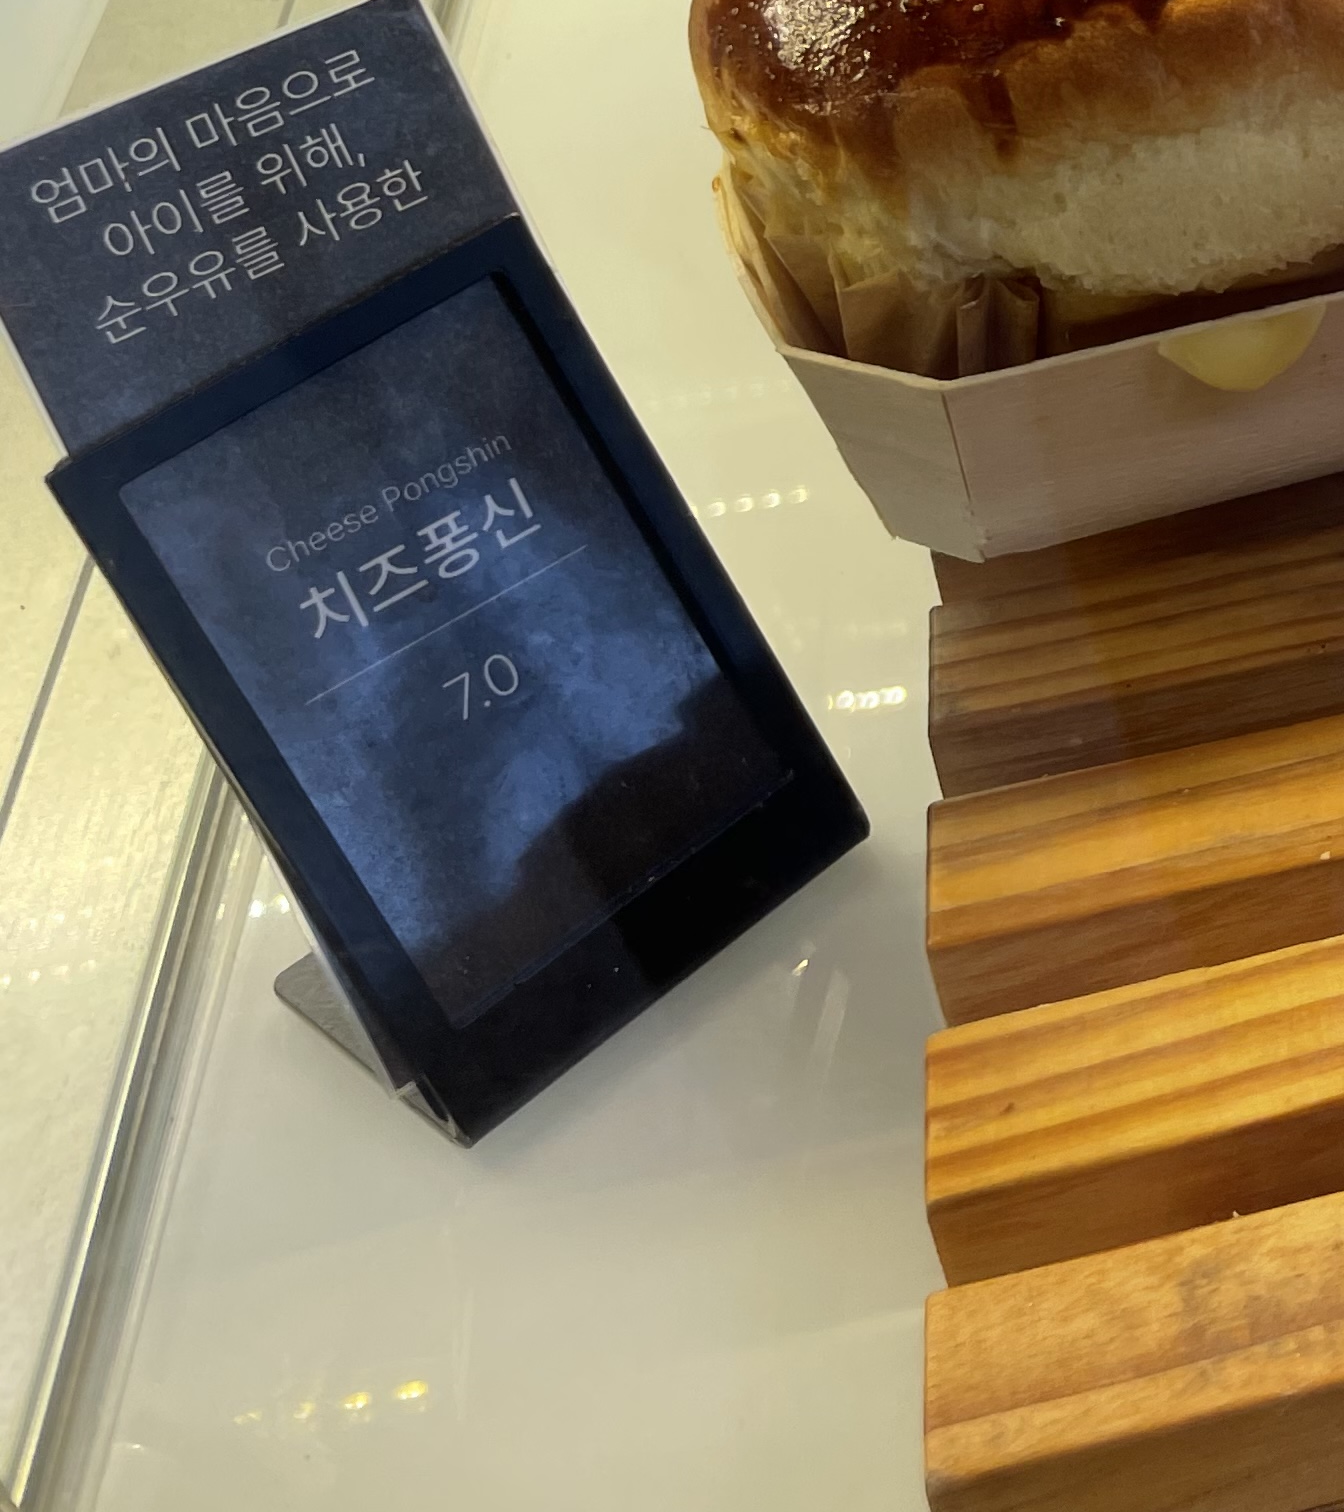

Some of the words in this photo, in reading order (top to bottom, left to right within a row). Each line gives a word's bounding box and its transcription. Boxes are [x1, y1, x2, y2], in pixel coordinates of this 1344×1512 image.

[31, 127, 181, 224] 엄마의
[186, 50, 375, 148] 마음으로
[103, 170, 251, 256] 아이를
[256, 123, 366, 195] 위해,
[96, 226, 285, 345] 순우유를
[298, 159, 428, 247] 사용한
[265, 504, 379, 572] Cheese
[381, 434, 512, 512] Pongshin
[300, 477, 541, 639] 치즈퐁신
[442, 654, 519, 720] 7.0
